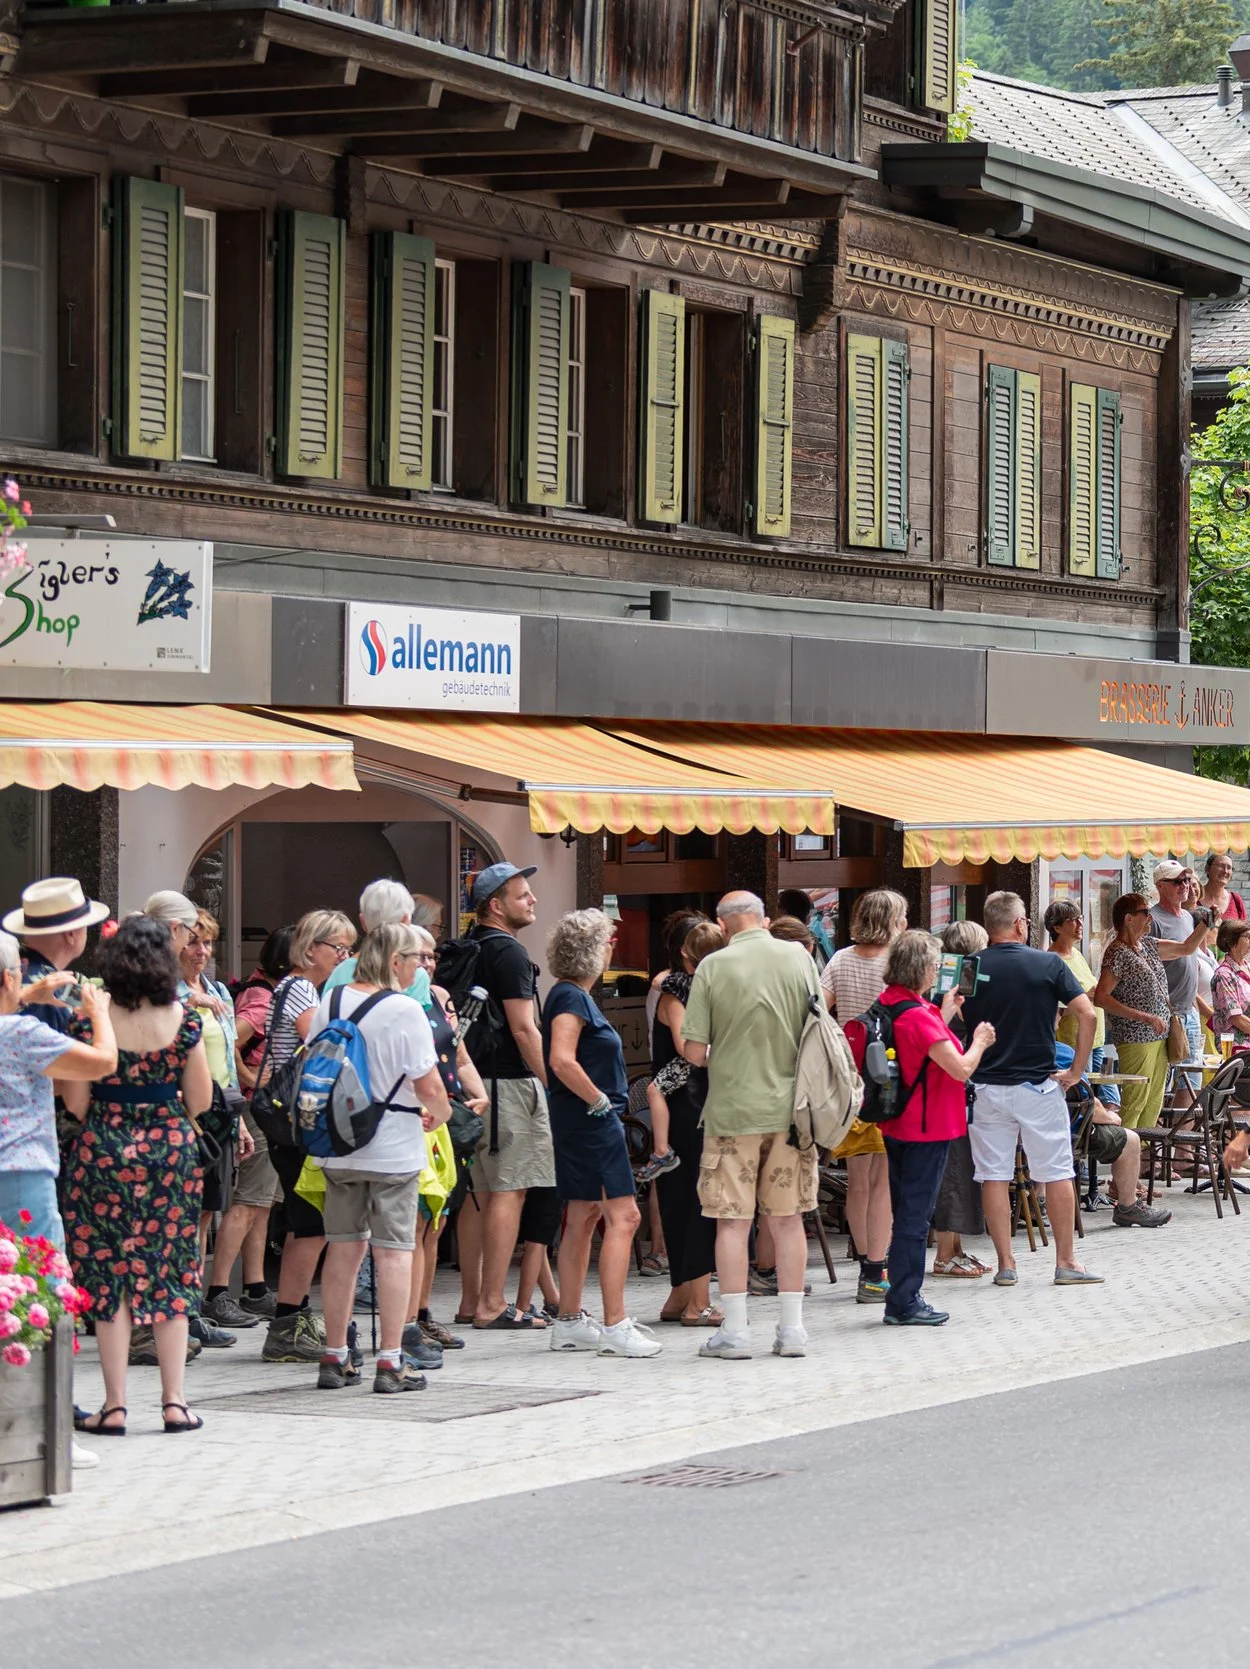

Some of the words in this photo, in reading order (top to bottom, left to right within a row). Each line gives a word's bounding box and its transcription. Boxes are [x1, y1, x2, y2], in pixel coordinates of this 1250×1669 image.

[391, 623, 511, 675] allemann
[442, 680, 511, 698] gebäudetechnik
[1099, 680, 1171, 724] BRASSERIE
[1192, 687, 1235, 728] ANKER
